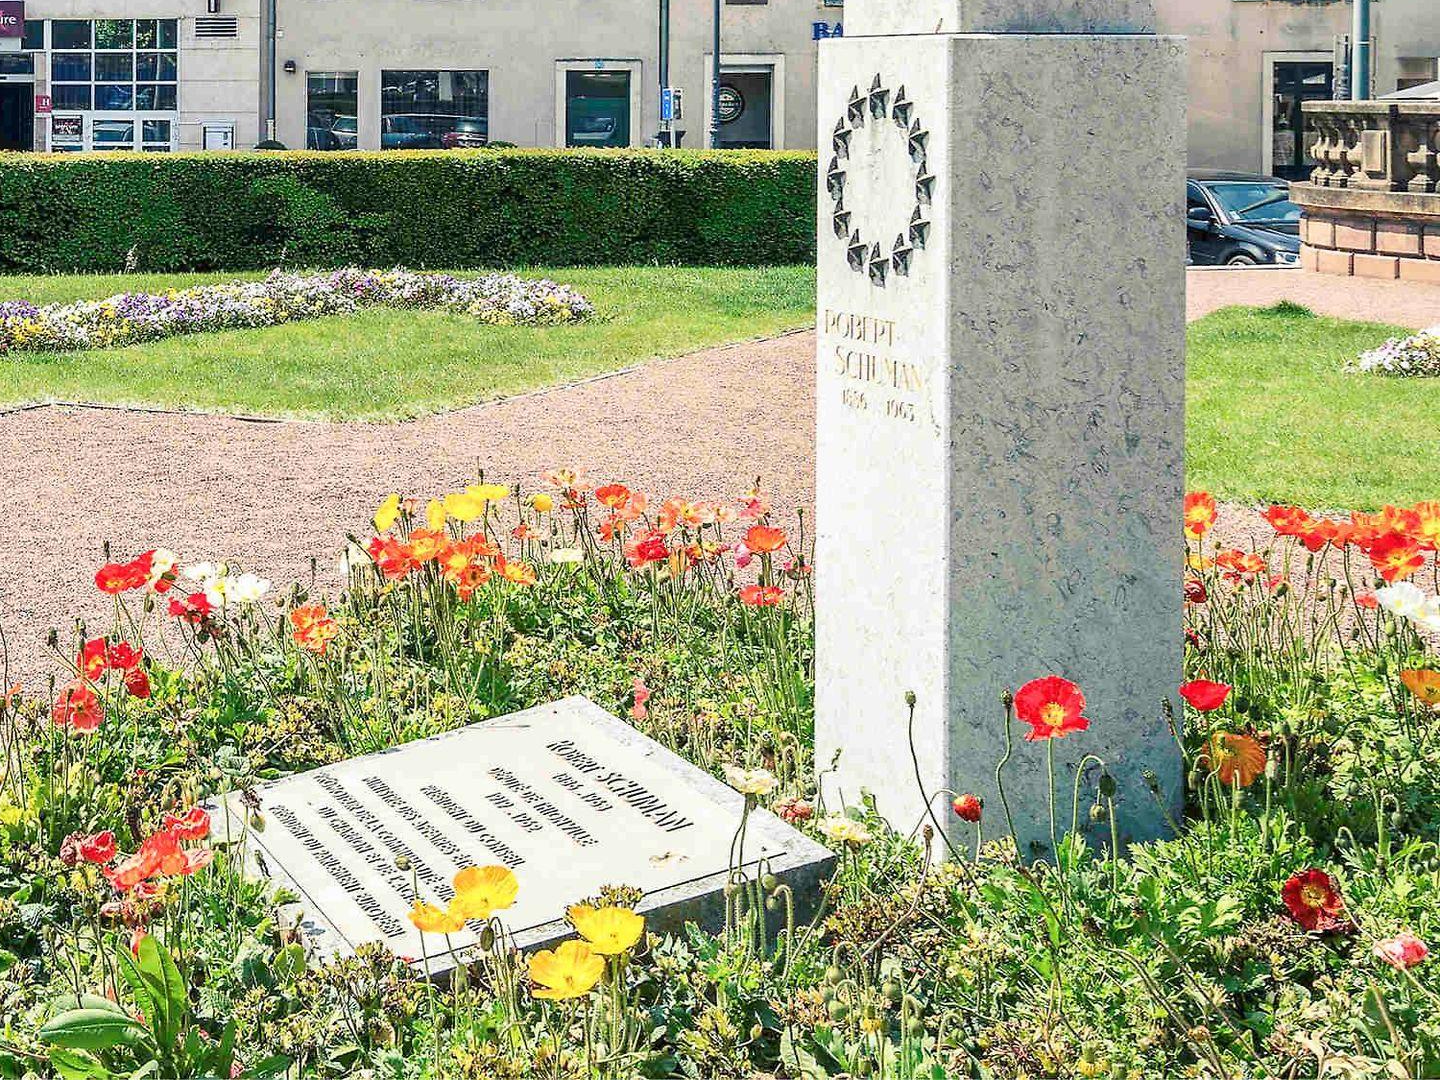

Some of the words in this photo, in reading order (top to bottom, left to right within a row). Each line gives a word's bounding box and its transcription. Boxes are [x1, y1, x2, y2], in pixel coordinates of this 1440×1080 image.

[825, 309, 896, 347] ROBERT
[546, 740, 606, 774] ROBERT
[597, 772, 694, 833] SCHUMAN
